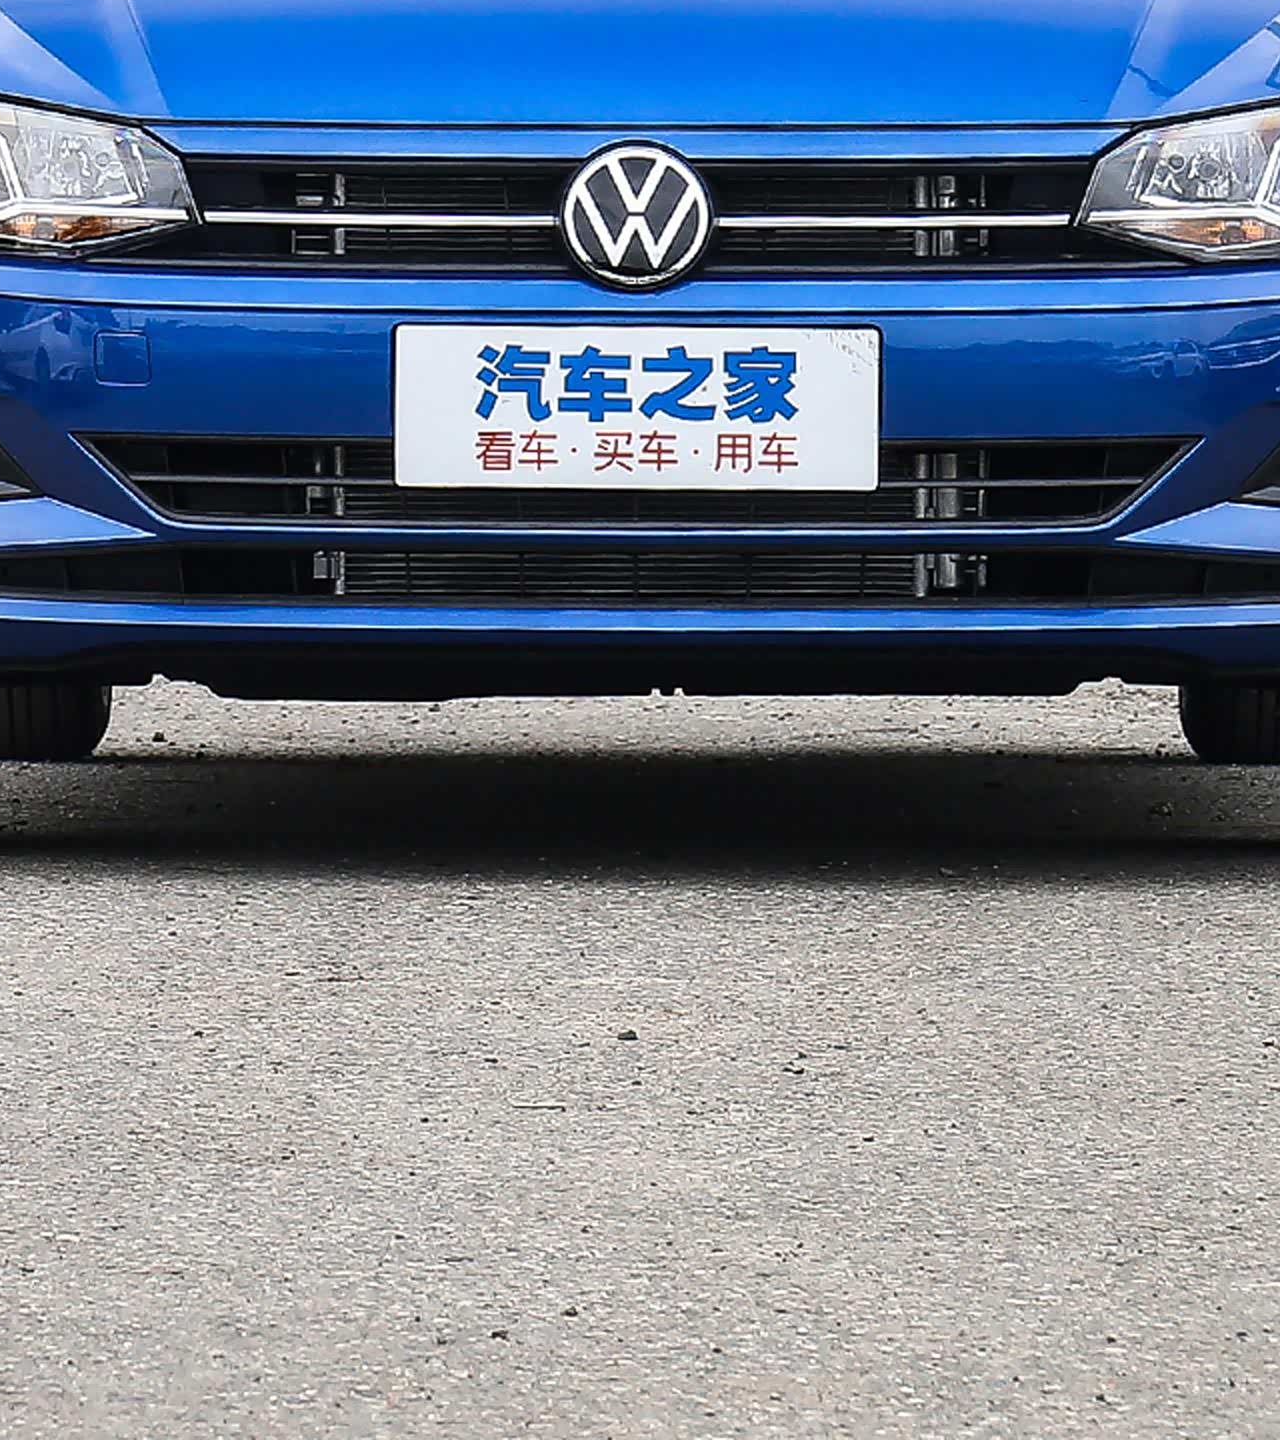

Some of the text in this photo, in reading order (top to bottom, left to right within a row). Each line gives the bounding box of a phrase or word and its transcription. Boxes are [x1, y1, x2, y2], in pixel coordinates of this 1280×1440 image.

[570, 150, 703, 270] VW
[474, 344, 800, 423] 汽车之家
